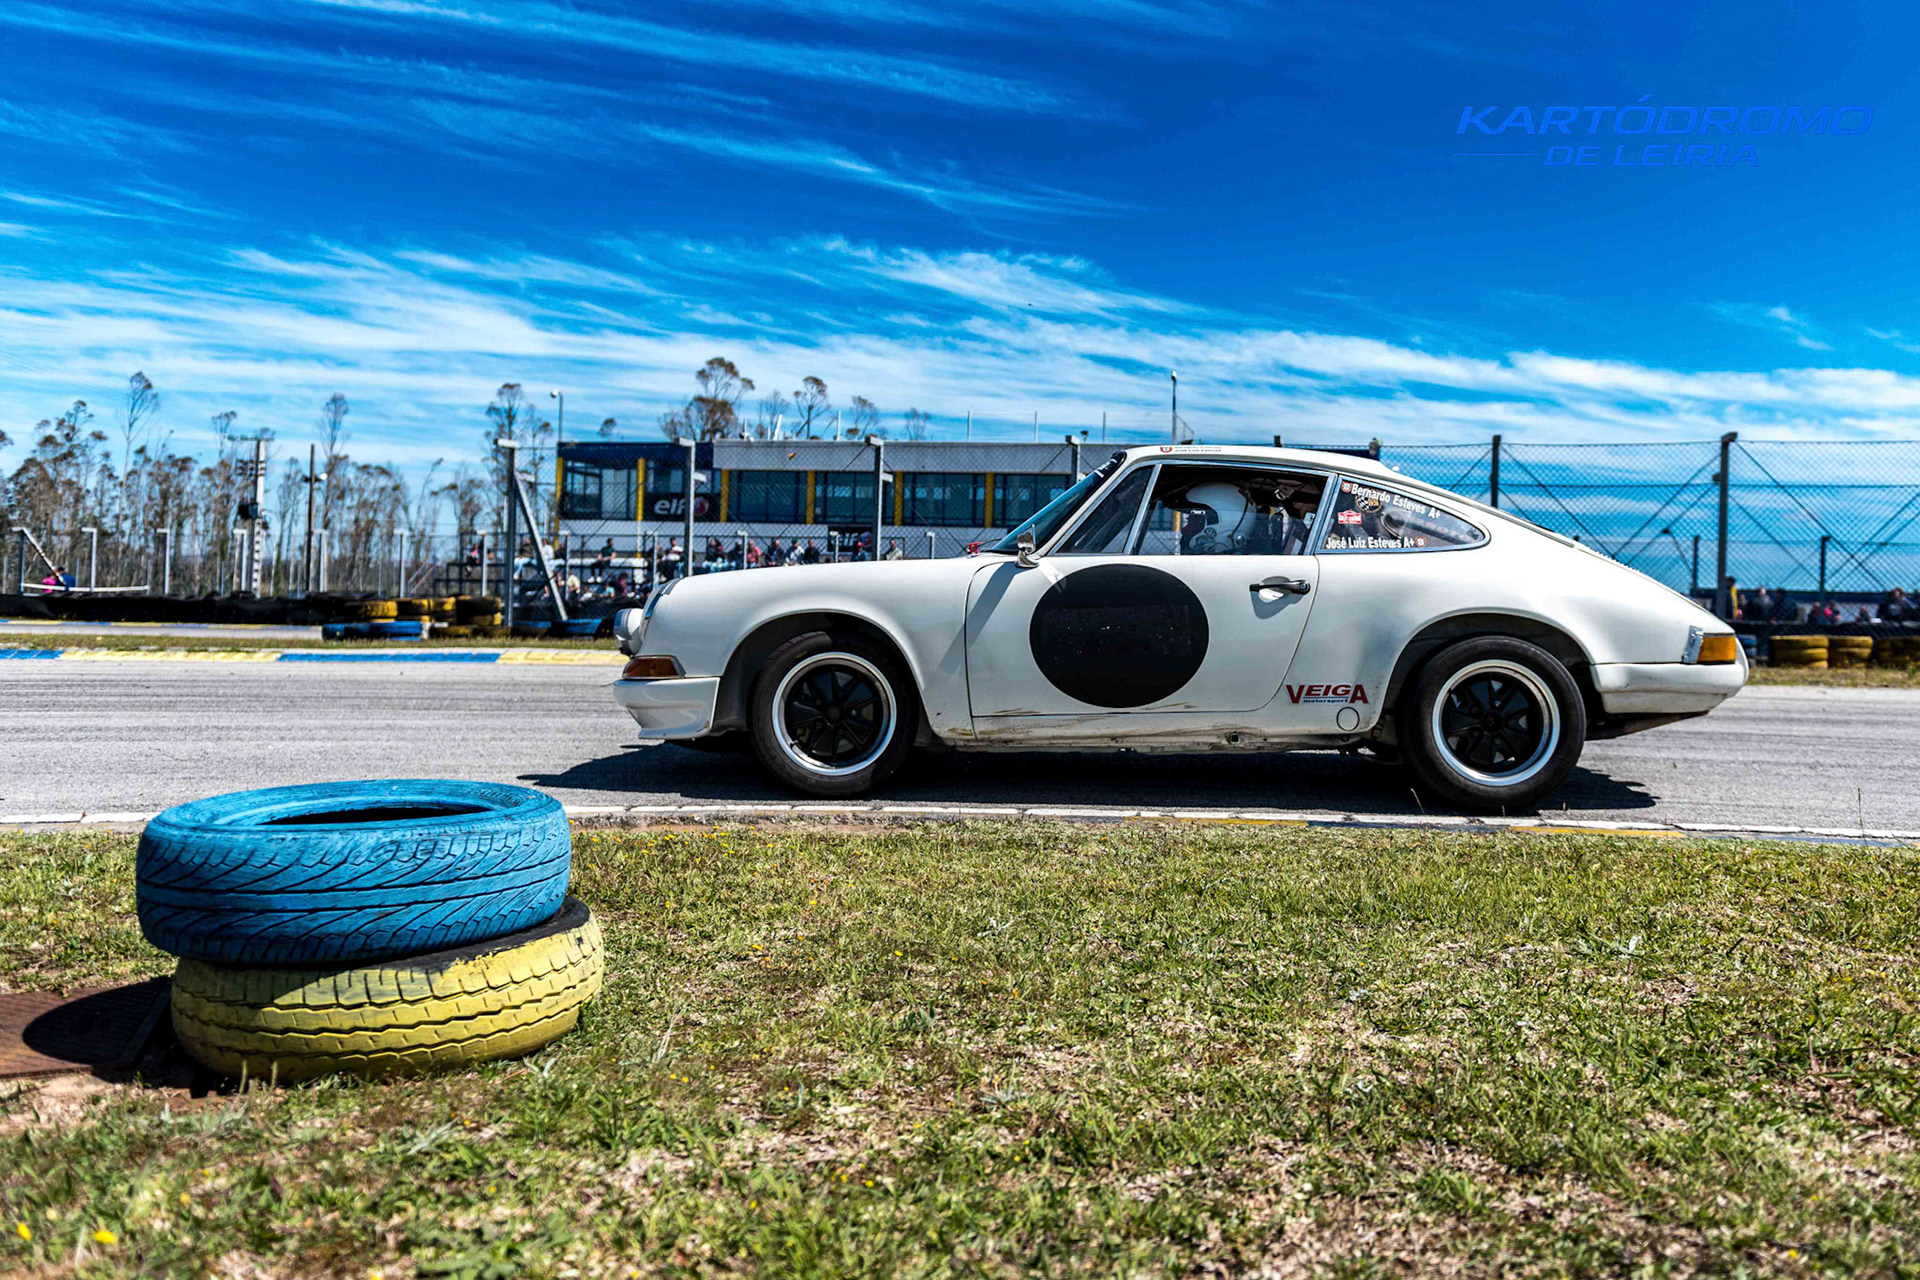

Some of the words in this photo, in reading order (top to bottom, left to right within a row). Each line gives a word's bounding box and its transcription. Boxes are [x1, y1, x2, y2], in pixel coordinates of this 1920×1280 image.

[1351, 483, 1391, 503] Bernardo
[1392, 496, 1426, 514] Esteves
[1428, 508, 1441, 519] A+
[1326, 536, 1347, 549] José
[1348, 537, 1366, 548] Luiz
[1368, 537, 1401, 548] Esteves
[1403, 537, 1415, 548] A+
[1285, 684, 1369, 704] VEIGA
